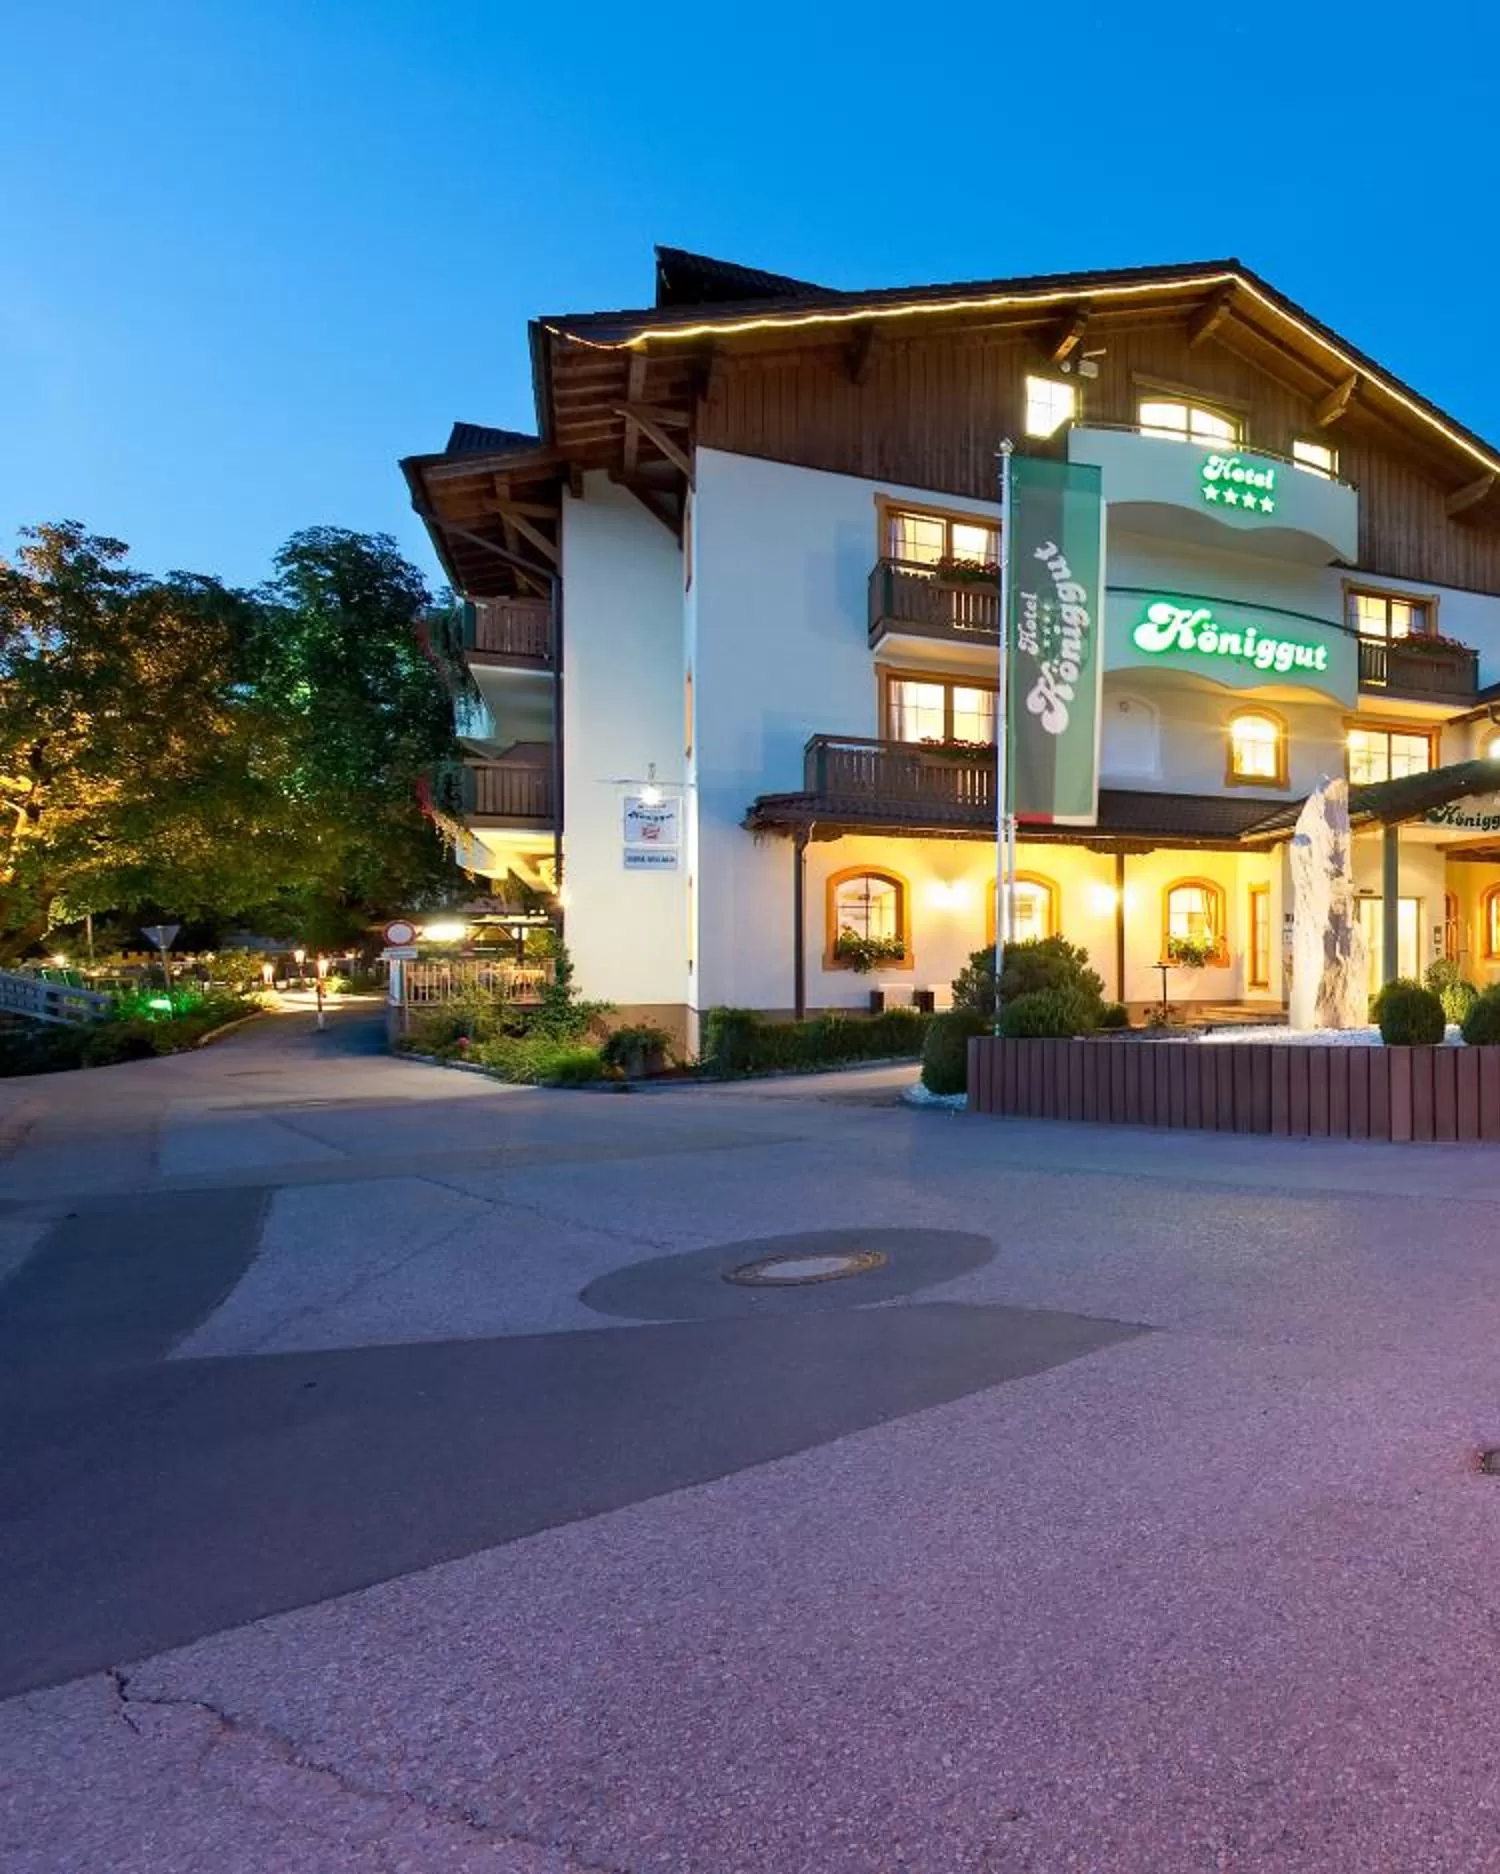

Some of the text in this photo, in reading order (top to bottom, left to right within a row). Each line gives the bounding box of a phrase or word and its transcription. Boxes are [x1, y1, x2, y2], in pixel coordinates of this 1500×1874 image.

[1202, 455, 1275, 490] Hotel
[1017, 592, 1039, 655] Hotel
[1026, 541, 1090, 735] Königgut
[1133, 602, 1328, 672] Königgut
